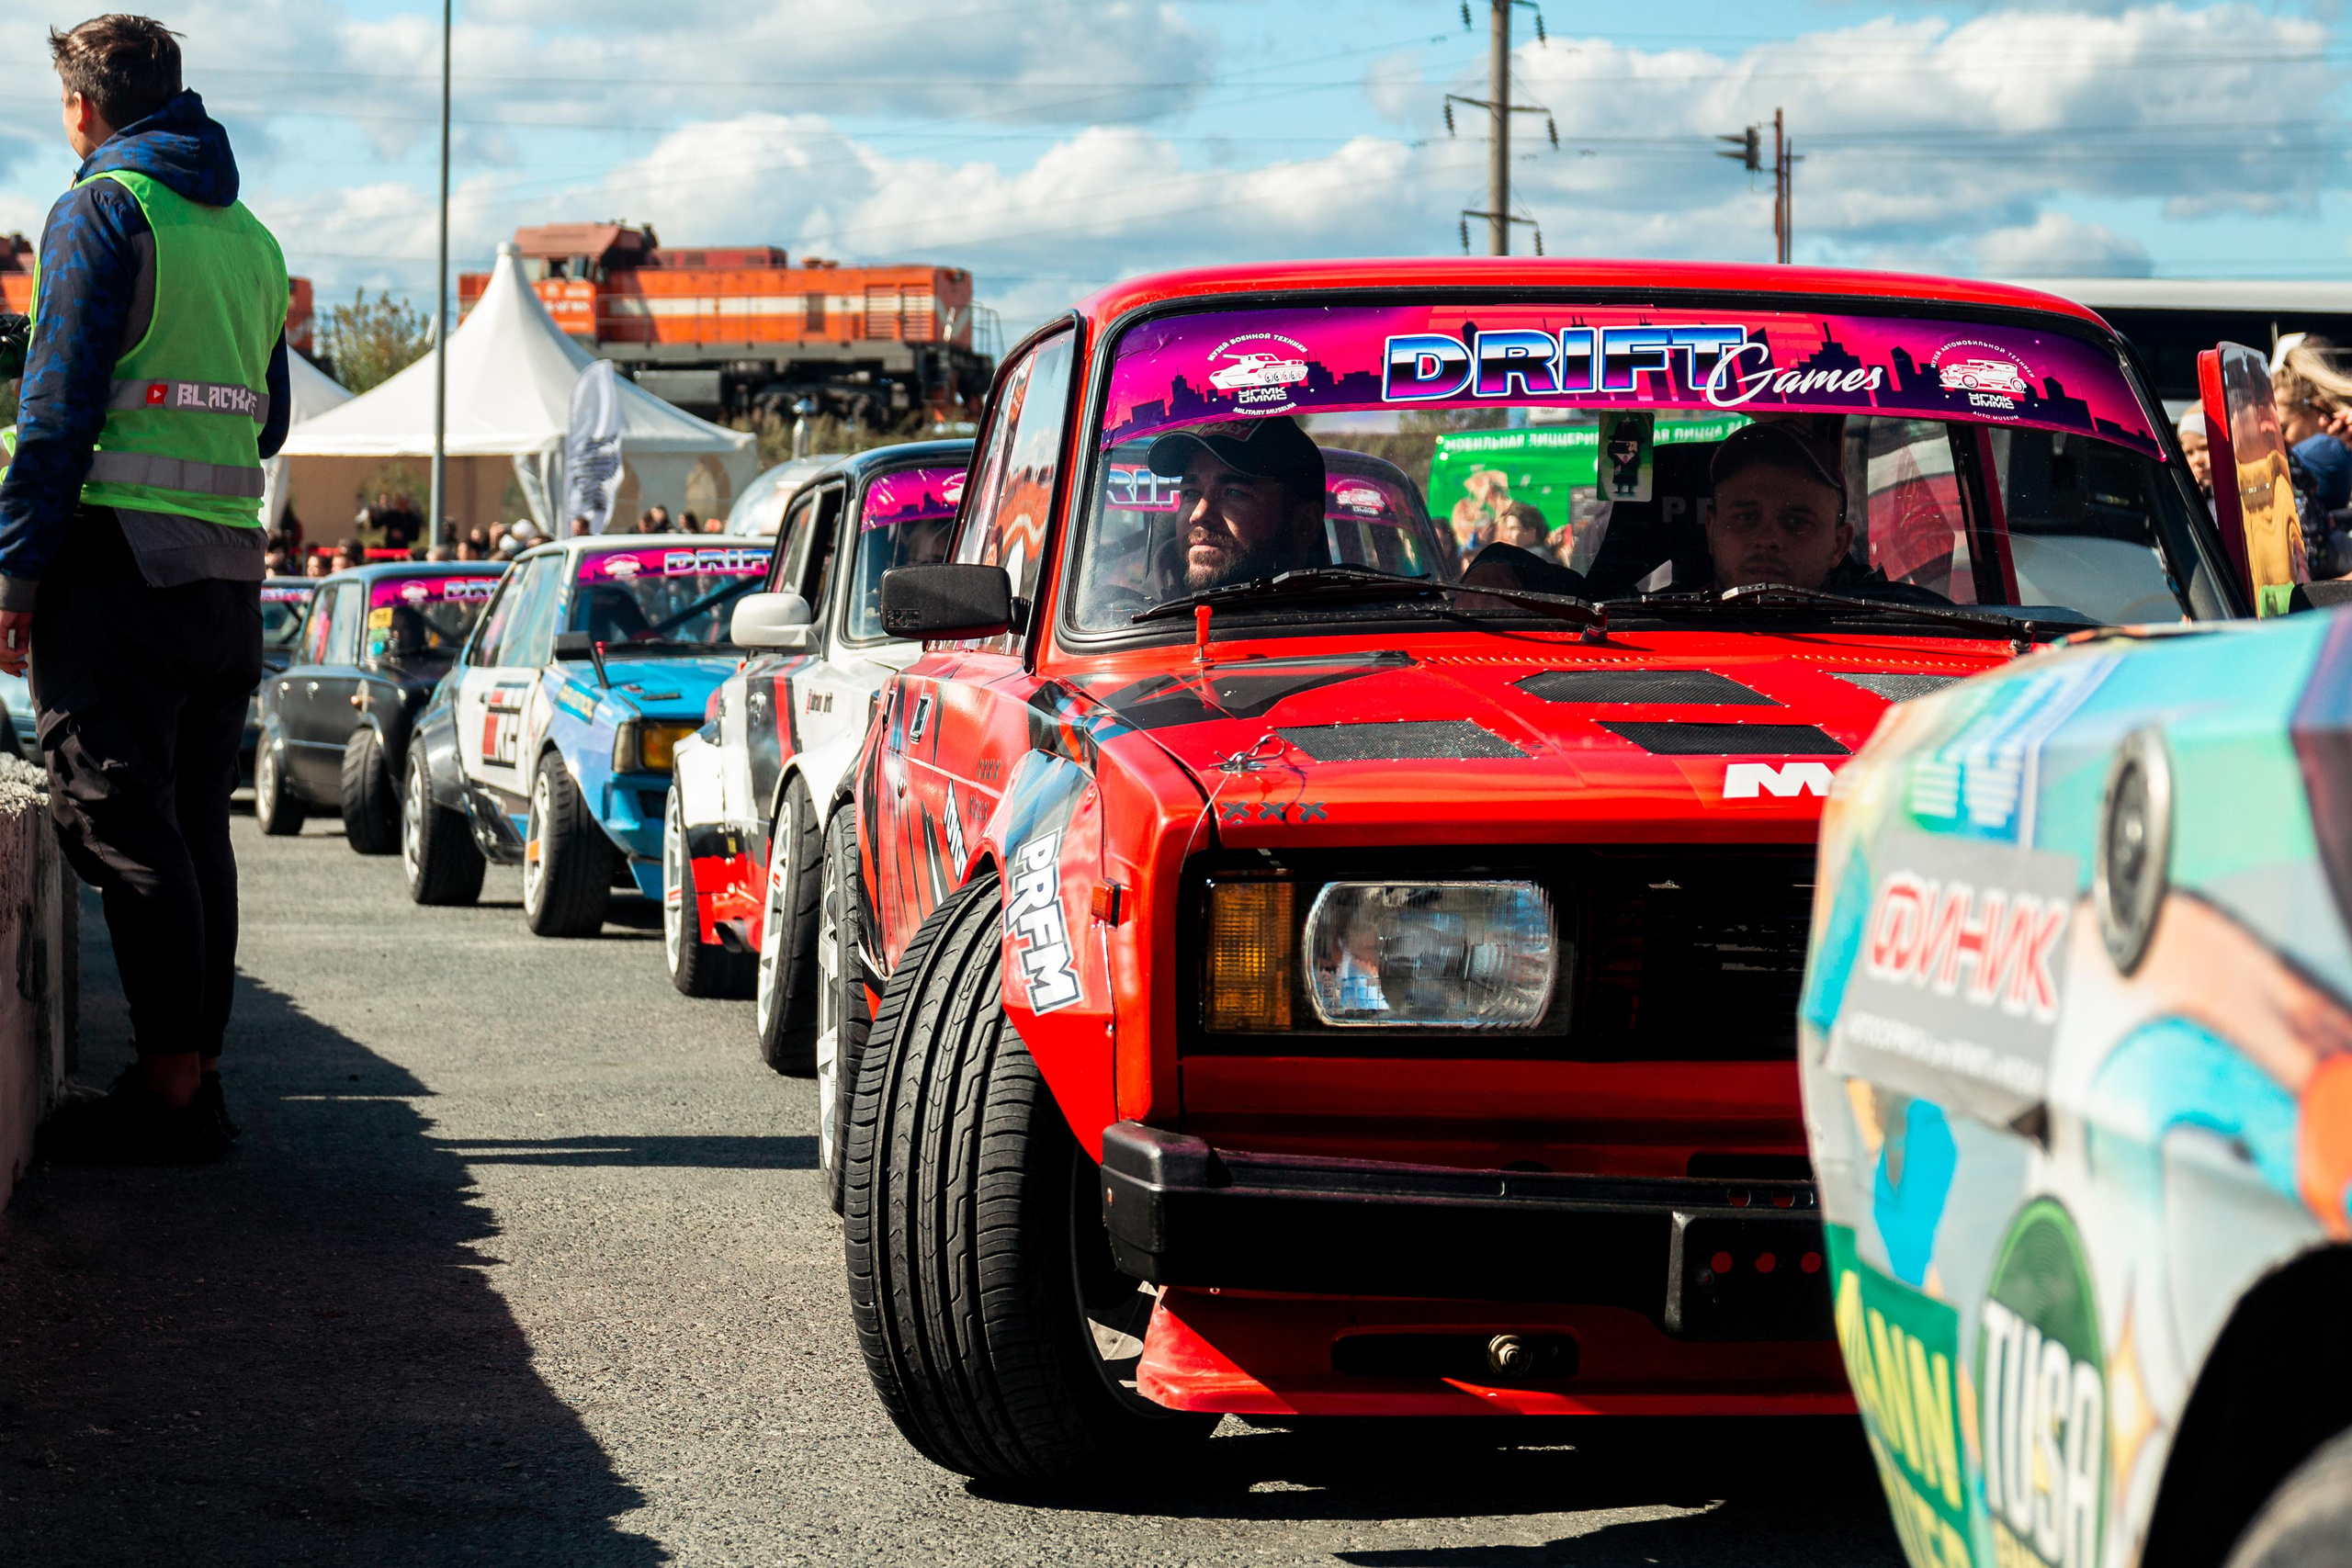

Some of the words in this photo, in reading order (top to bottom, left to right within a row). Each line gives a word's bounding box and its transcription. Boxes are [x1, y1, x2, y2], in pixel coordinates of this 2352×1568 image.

[1207, 342, 1230, 361] МУЗЕЙ
[1229, 333, 1272, 345] ВОЕННОЙ
[1272, 333, 1308, 353] ТЕХНИКИ
[1383, 325, 1746, 401] DRIFT
[1929, 350, 1942, 368] МУЗЕЙ
[1940, 340, 2006, 354] АВТОМОБИЛЬНОЙ
[2007, 352, 2036, 378] ТЕХНИКИ
[1705, 342, 1883, 408] Games
[1232, 407, 1266, 416] MILITARY
[1266, 401, 1297, 415] MUSEUM
[1238, 387, 1286, 397] УГМК
[1238, 393, 1288, 404] UMMC
[1973, 411, 1992, 419] AUTO
[1992, 413, 2020, 422] MUSEUM
[1006, 829, 1081, 1013] PRFM
[1864, 871, 2069, 1024] ФИНИК
